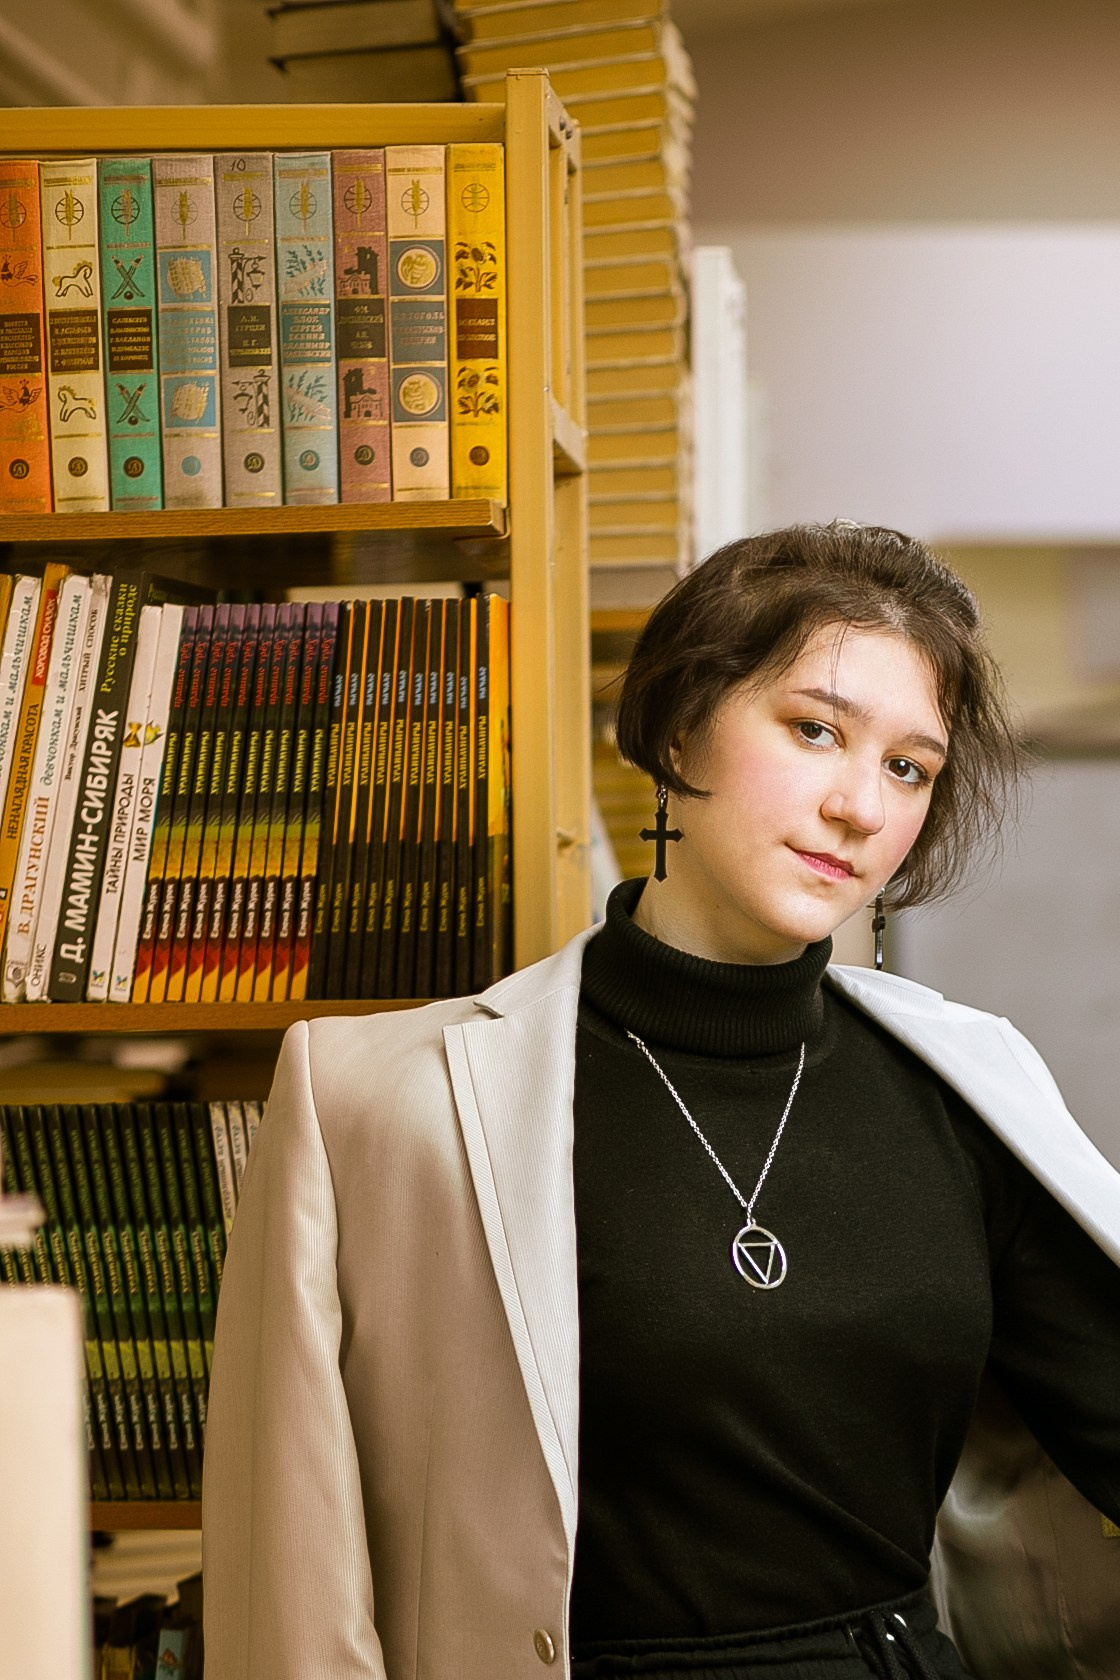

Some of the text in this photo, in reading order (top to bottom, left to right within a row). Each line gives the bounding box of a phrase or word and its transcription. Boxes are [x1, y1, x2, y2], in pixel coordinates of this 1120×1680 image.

[230, 158, 246, 172] 10
[100, 584, 128, 693] Русские сказки
[119, 584, 138, 656] о природе
[9, 596, 33, 693] мальчишкам
[35, 634, 50, 678] ХОРОВОД
[174, 669, 185, 708] правило
[190, 668, 200, 708] правило
[206, 668, 217, 706] правило
[221, 668, 231, 707] правило
[238, 668, 248, 706] правило
[255, 668, 265, 706] правило
[270, 666, 280, 704] правило
[286, 666, 296, 704] правило
[302, 666, 312, 704] правило
[318, 665, 329, 704] правило
[7, 703, 39, 839] НЕНАГЛЯДНАЯ КРАСОТА
[17, 594, 82, 934] В. ДРАГУНСКИЙ девчонкам и мальчишкам
[30, 943, 47, 986] ОНИКС
[78, 652, 91, 692] ХИТРЫЙ
[86, 608, 98, 648] СПОСОБ
[60, 709, 118, 963] Д. МАМИН-СИБИРЯК
[105, 774, 134, 894] ТАЙНЫ ПРИРОДЫ
[132, 778, 156, 862] МИР МОРЯ
